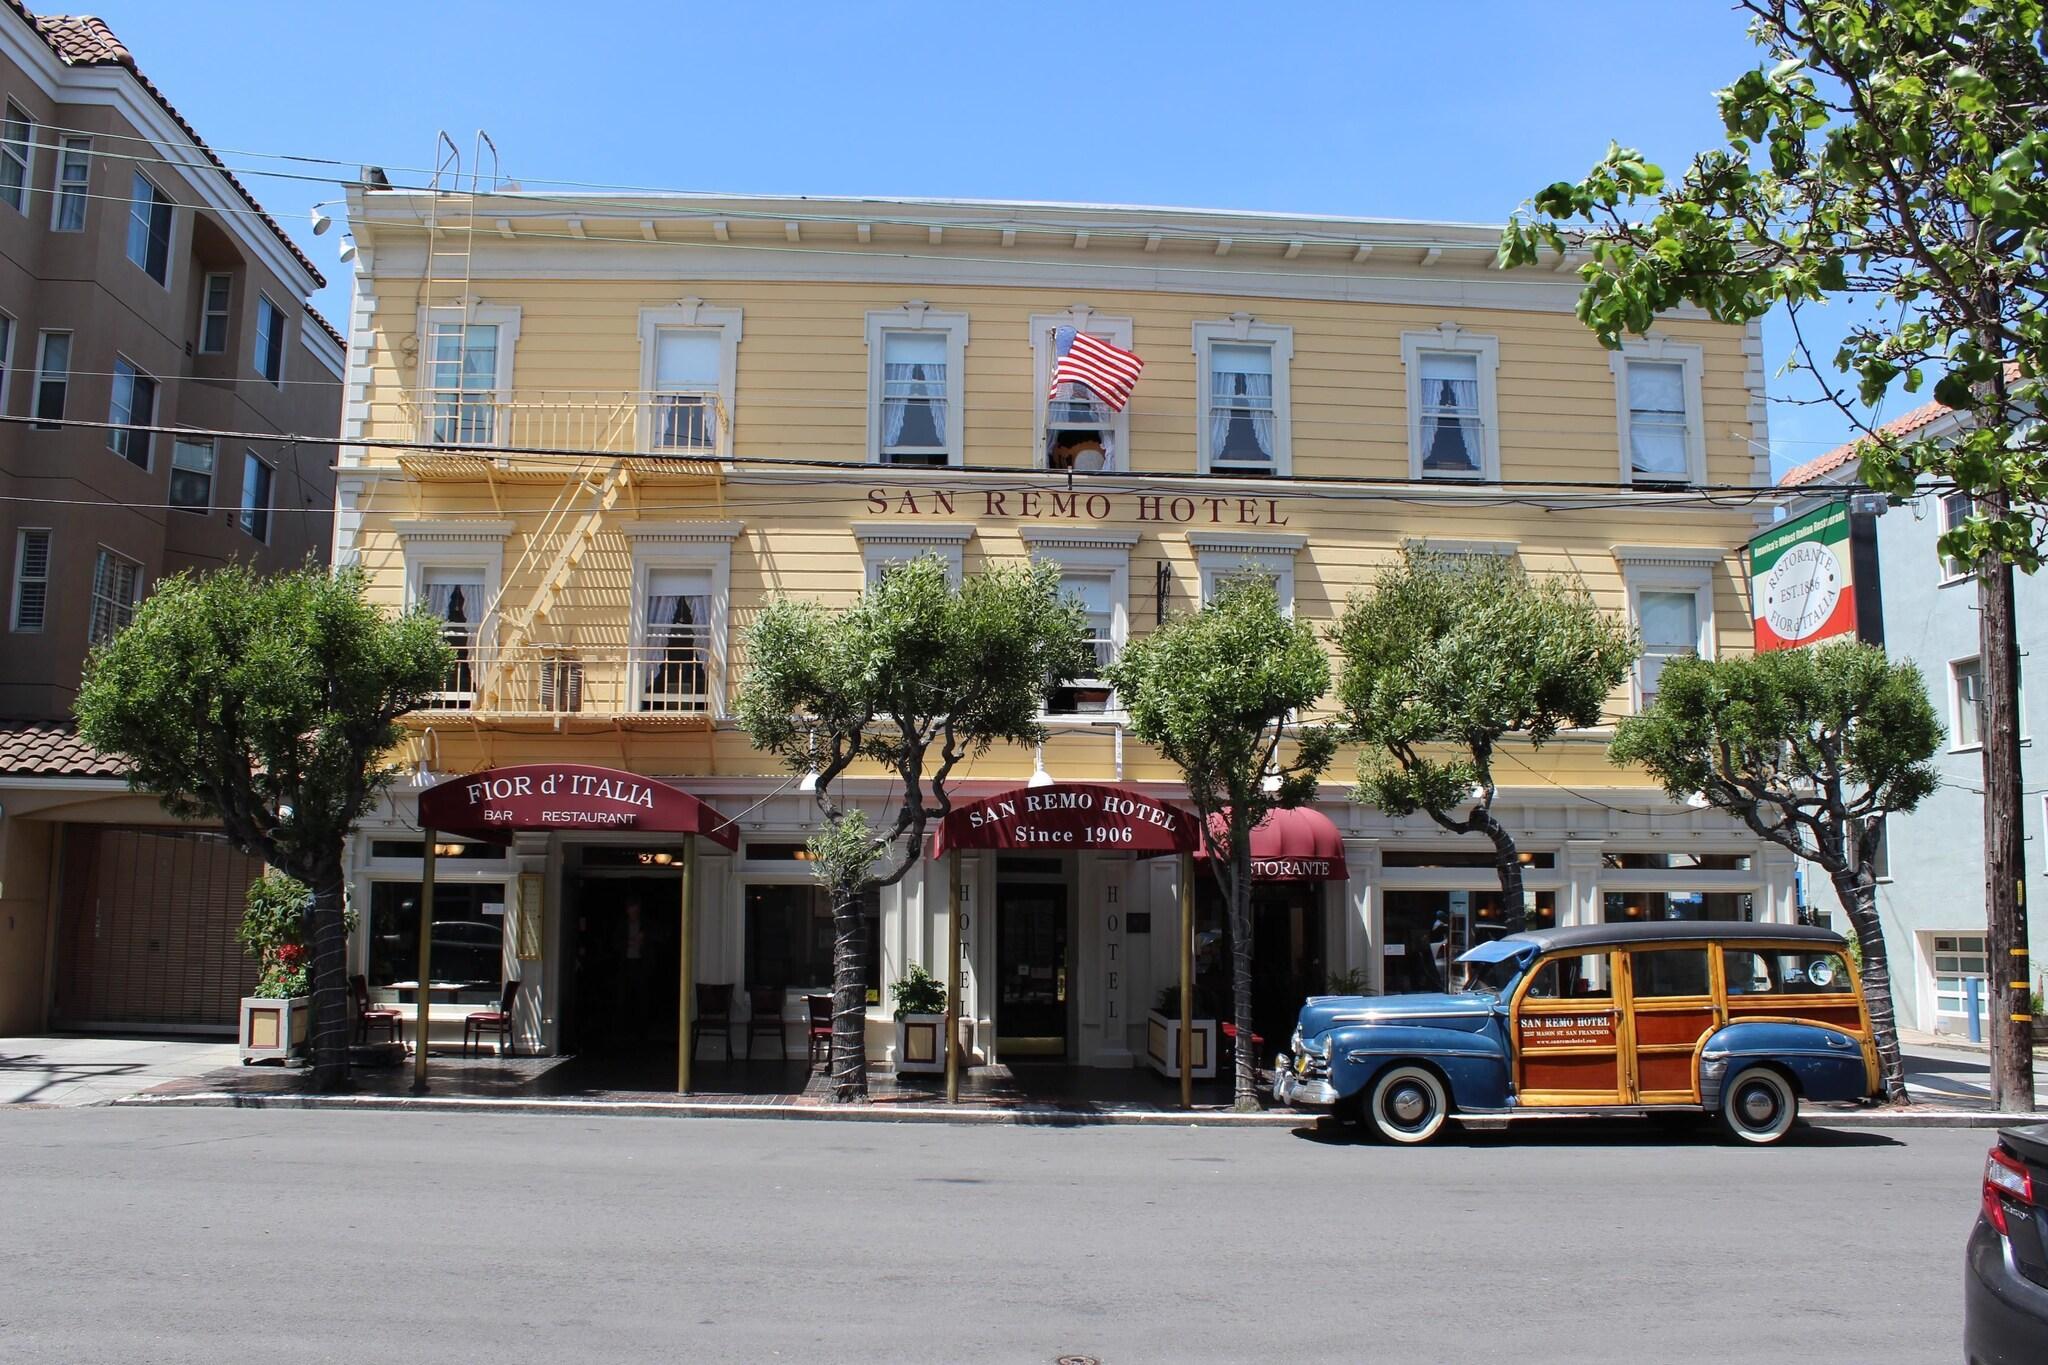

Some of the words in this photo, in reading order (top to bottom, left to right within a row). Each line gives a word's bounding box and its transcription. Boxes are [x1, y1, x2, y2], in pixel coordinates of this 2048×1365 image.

[867, 488, 956, 515] SAN
[983, 490, 1112, 520] REMO
[1137, 496, 1290, 526] HOTEL
[1769, 547, 1833, 590] RISTORANTE
[466, 776, 533, 805] FIOR
[570, 775, 655, 809] ITALIA
[484, 810, 513, 821] BAR
[541, 811, 637, 824] RESTAURANT
[969, 799, 1017, 829] SAN
[1025, 792, 1093, 812] REMO
[1102, 796, 1178, 833] HOTEL
[1015, 825, 1074, 842] Since
[1085, 826, 1133, 843] 1906
[1250, 861, 1330, 875] TORANTE
[1107, 885, 1120, 1019] HOTEL
[1520, 1018, 1542, 1028] SAN
[1545, 1017, 1575, 1028] REMO
[1577, 1016, 1610, 1027] HOTEL
